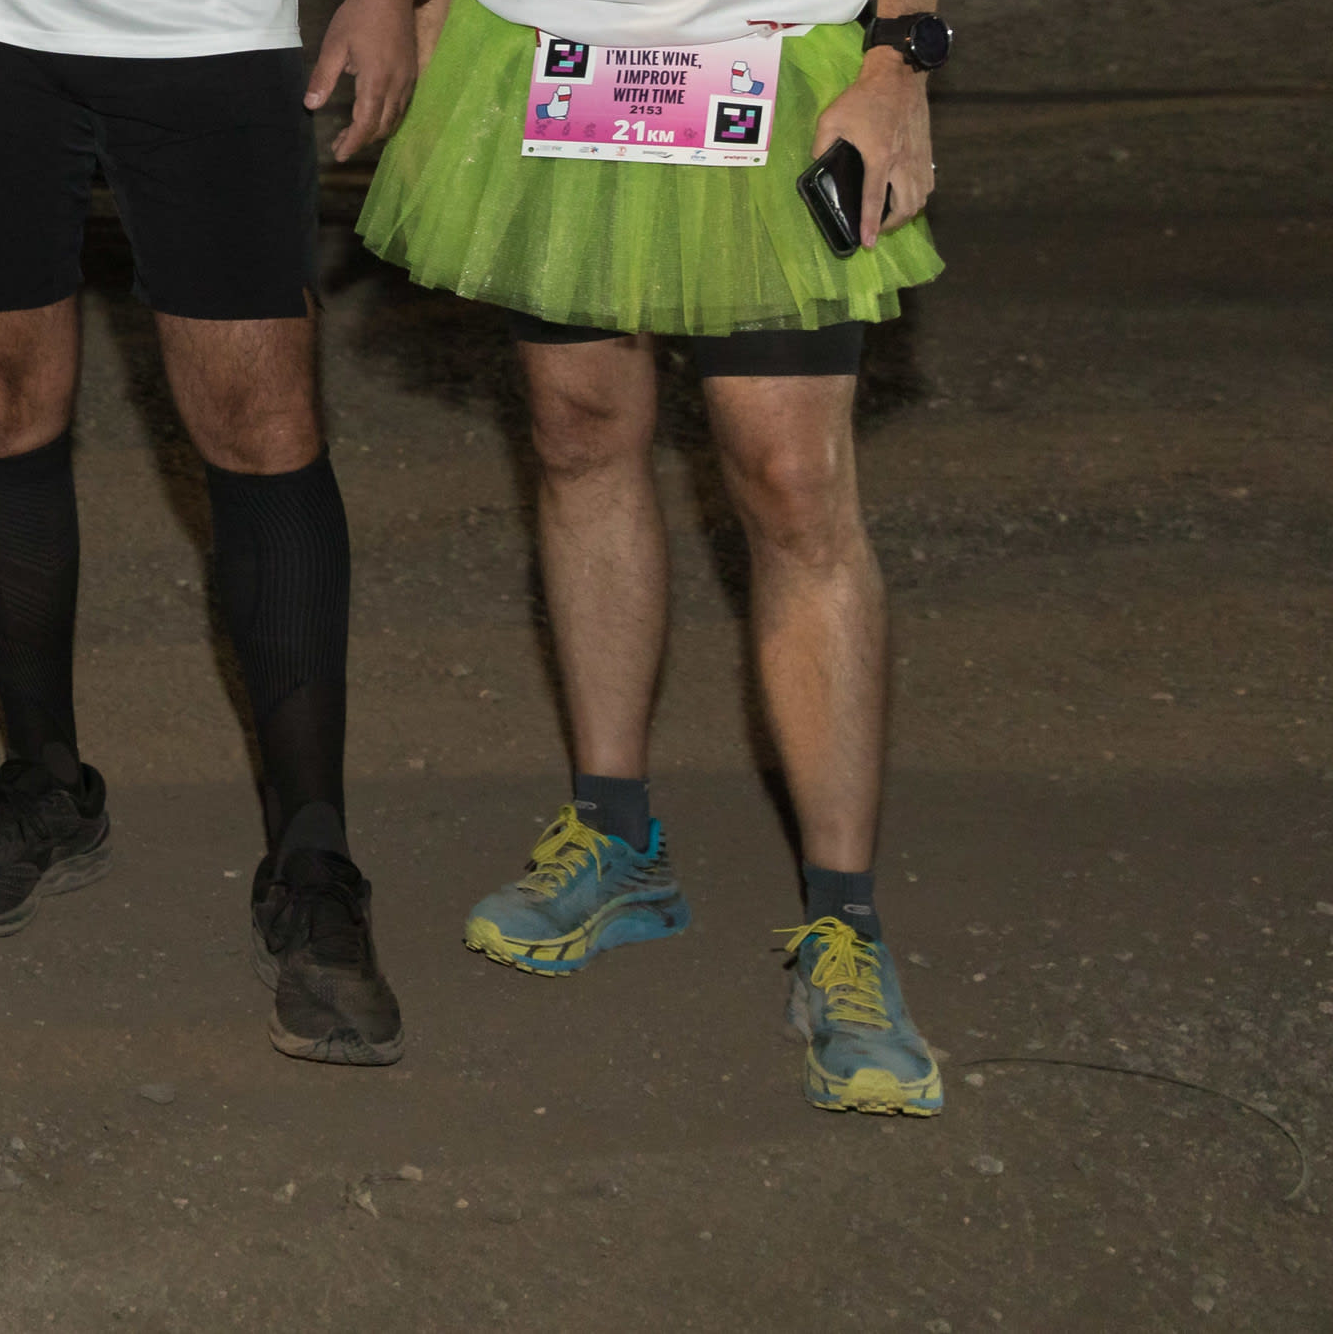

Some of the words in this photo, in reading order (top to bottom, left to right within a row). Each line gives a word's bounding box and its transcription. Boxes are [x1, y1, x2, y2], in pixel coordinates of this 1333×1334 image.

[606, 50, 627, 65] I'M
[630, 51, 659, 66] LIKE
[662, 52, 701, 69] WINE,
[616, 70, 622, 83] I
[624, 70, 687, 85] IMPROVE
[614, 88, 650, 102] WITH
[653, 89, 685, 104] TIME
[630, 106, 662, 115] 2153
